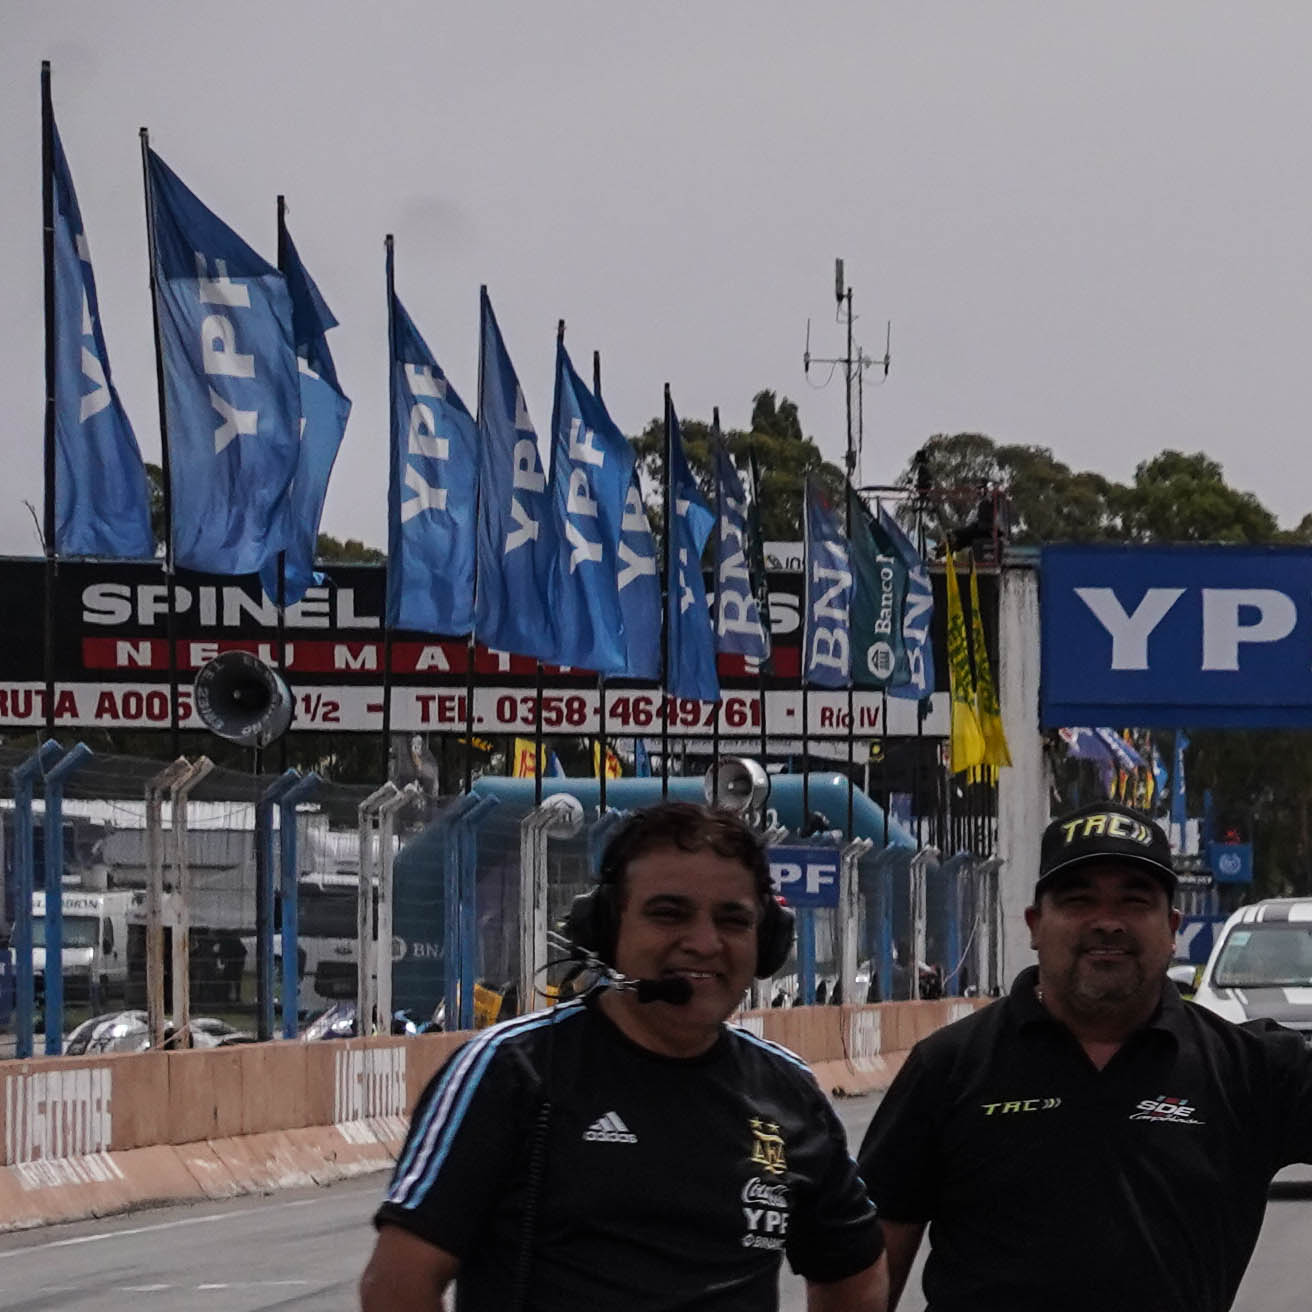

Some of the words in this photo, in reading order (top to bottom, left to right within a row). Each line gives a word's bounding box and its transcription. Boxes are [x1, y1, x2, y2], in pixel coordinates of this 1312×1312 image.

[401, 363, 449, 523] YPF
[566, 418, 604, 575] YPF
[875, 567, 894, 635] Banco
[860, 706, 880, 727] IV
[775, 864, 837, 894] PF
[1136, 1100, 1195, 1117] SDE
[582, 1130, 639, 1144] adidas
